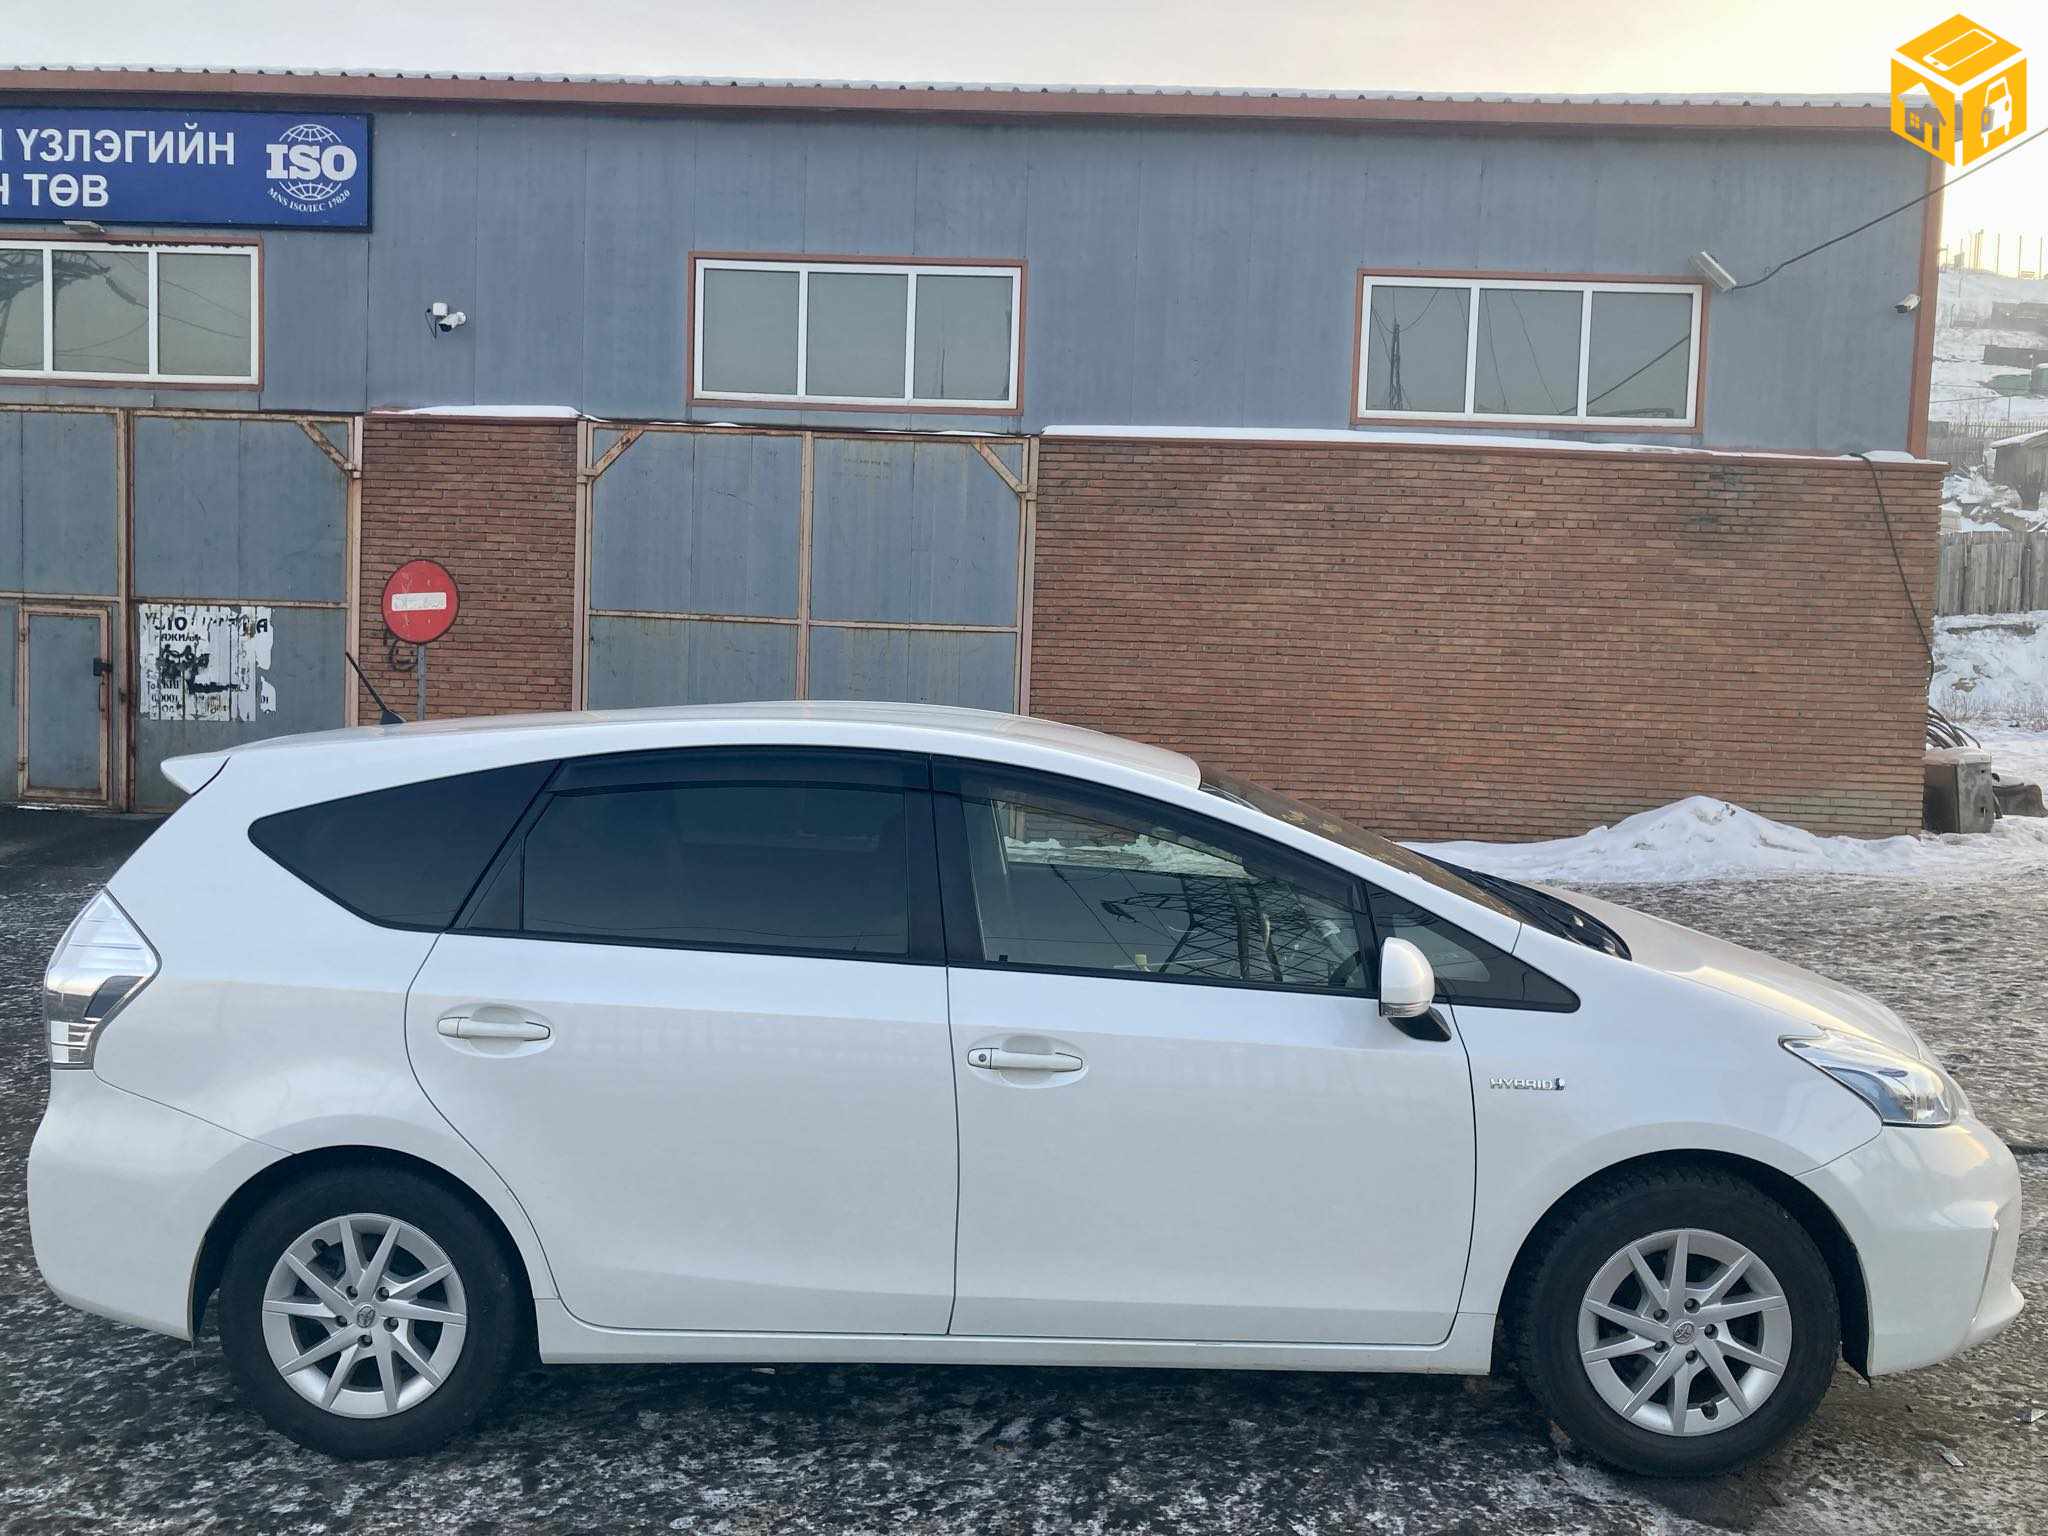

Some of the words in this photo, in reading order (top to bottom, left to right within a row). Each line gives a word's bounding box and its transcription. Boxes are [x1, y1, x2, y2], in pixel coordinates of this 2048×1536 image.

[16, 122, 235, 165] ҮЗЛЭГИЙН
[266, 144, 357, 181] ISO
[23, 173, 109, 207] ТӨВ
[1489, 1078, 1553, 1091] HYBRID
